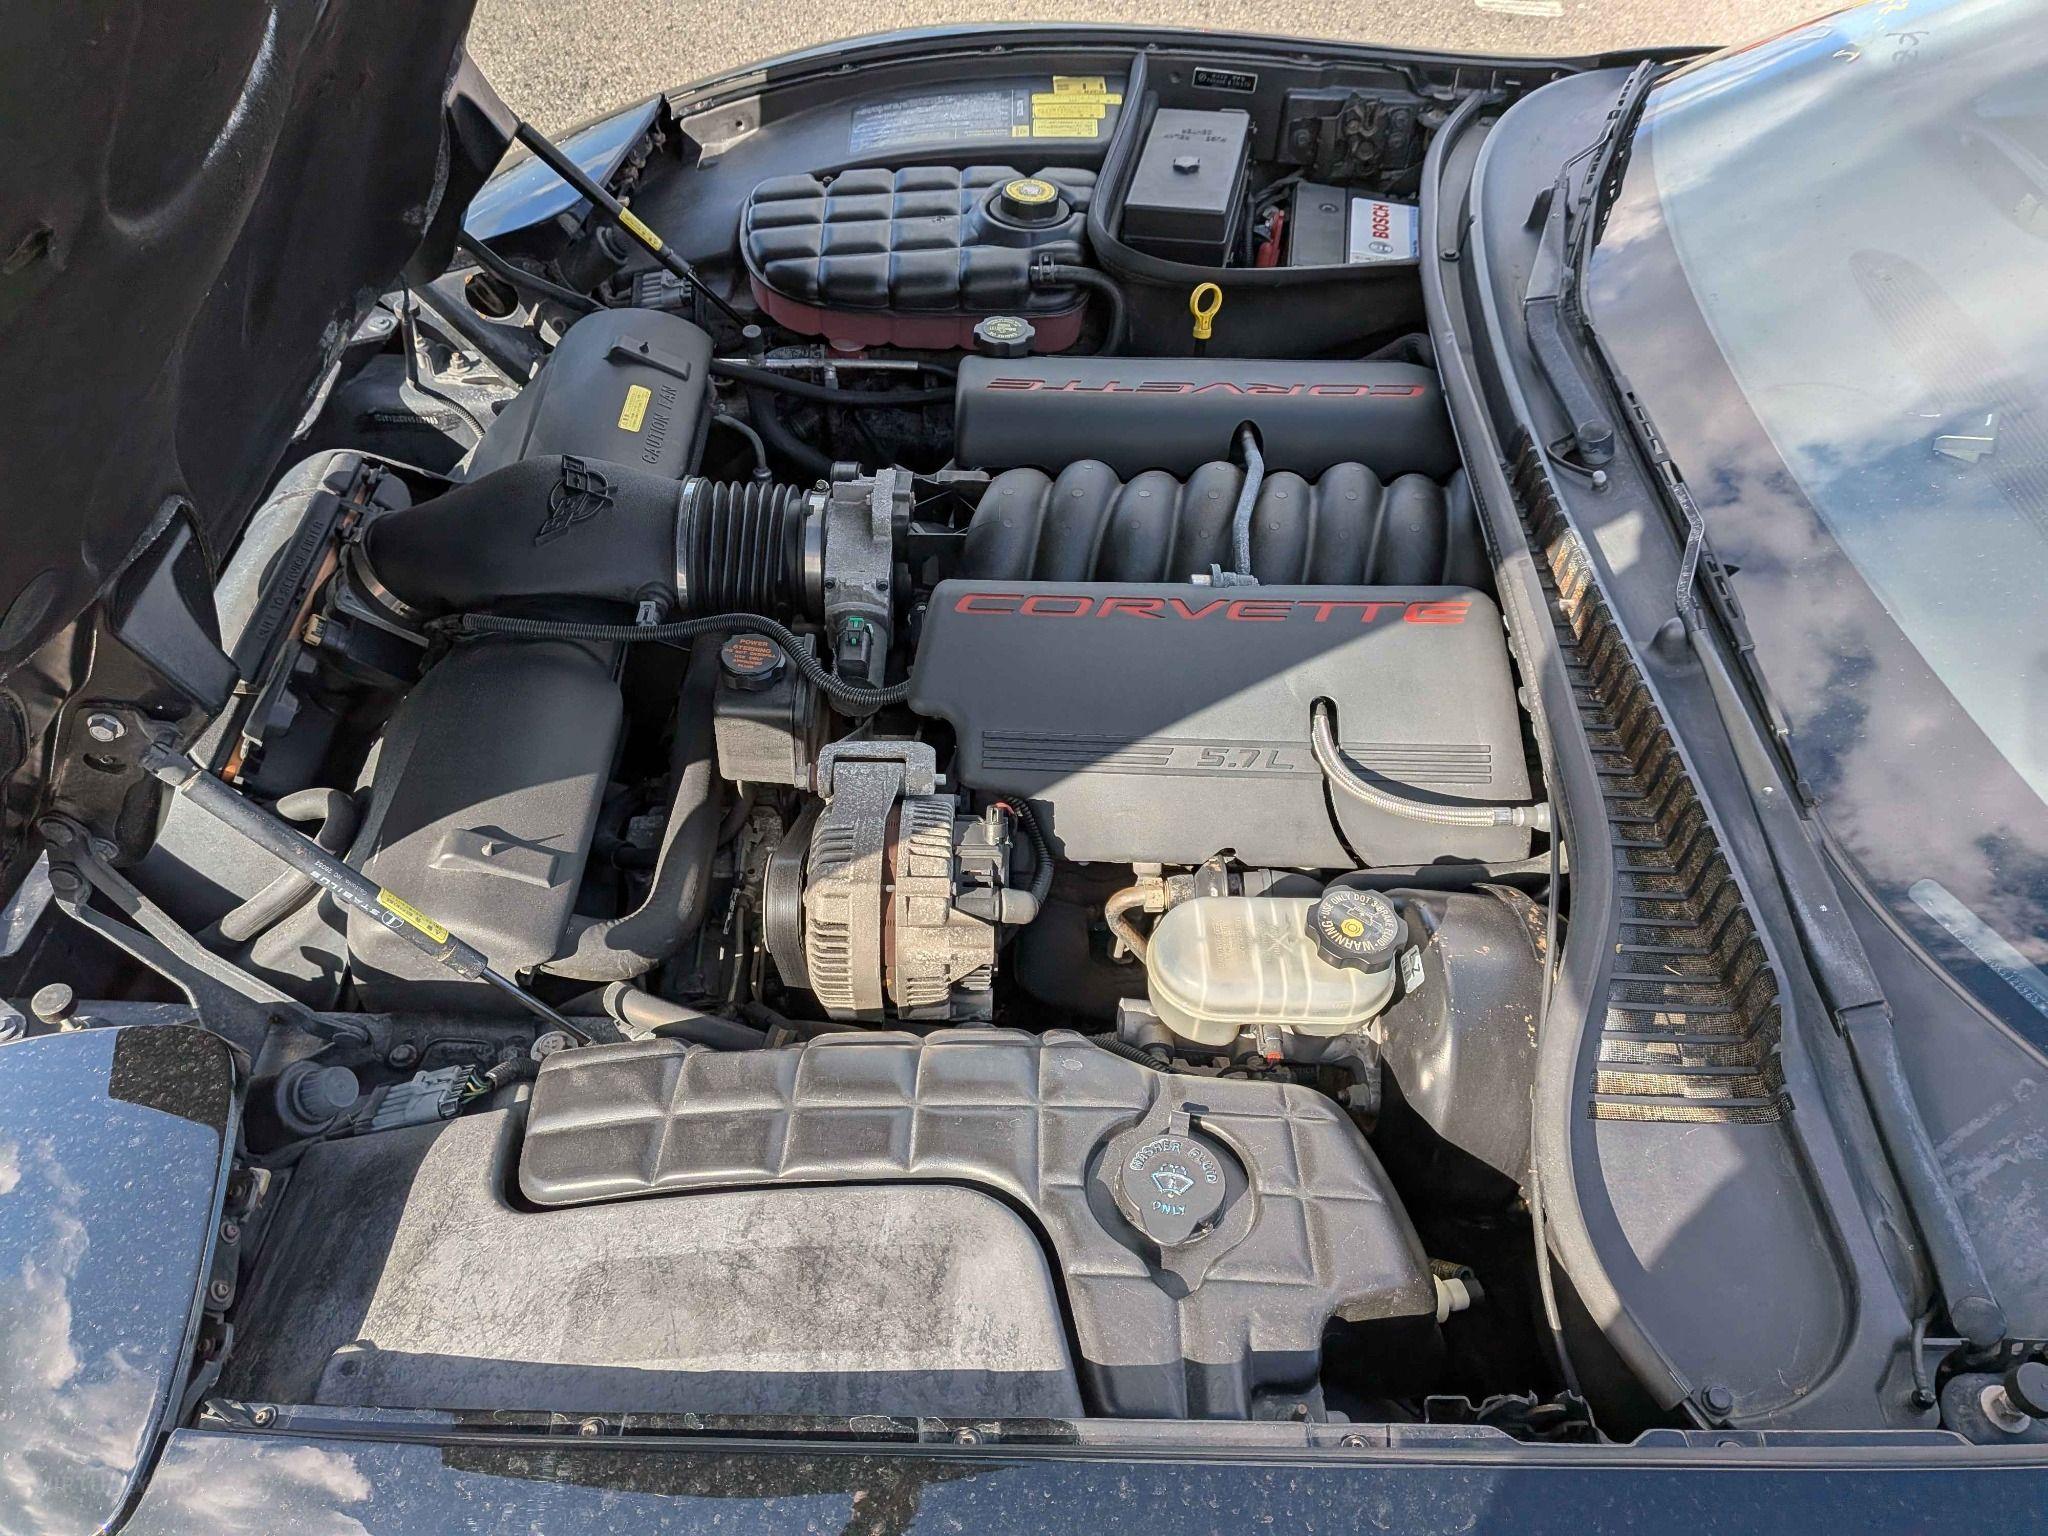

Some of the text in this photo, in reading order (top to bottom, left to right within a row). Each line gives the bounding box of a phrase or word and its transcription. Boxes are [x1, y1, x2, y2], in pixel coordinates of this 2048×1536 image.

[1372, 203, 1389, 239] BOSCH
[986, 378, 1425, 399] CORVETTE
[642, 385, 677, 464] CAUTION FAN
[955, 593, 1472, 625] CORVETTE
[740, 639, 769, 647] POWER
[1196, 747, 1295, 771] 5.7L
[310, 870, 380, 916] STABILUS
[1321, 902, 1334, 915] USE
[1330, 892, 1351, 905] ONLY
[1354, 893, 1372, 903] DOT
[1321, 920, 1375, 951] WARNING
[1129, 1139, 1182, 1171] WASHER
[1152, 1201, 1187, 1216] ONLY
